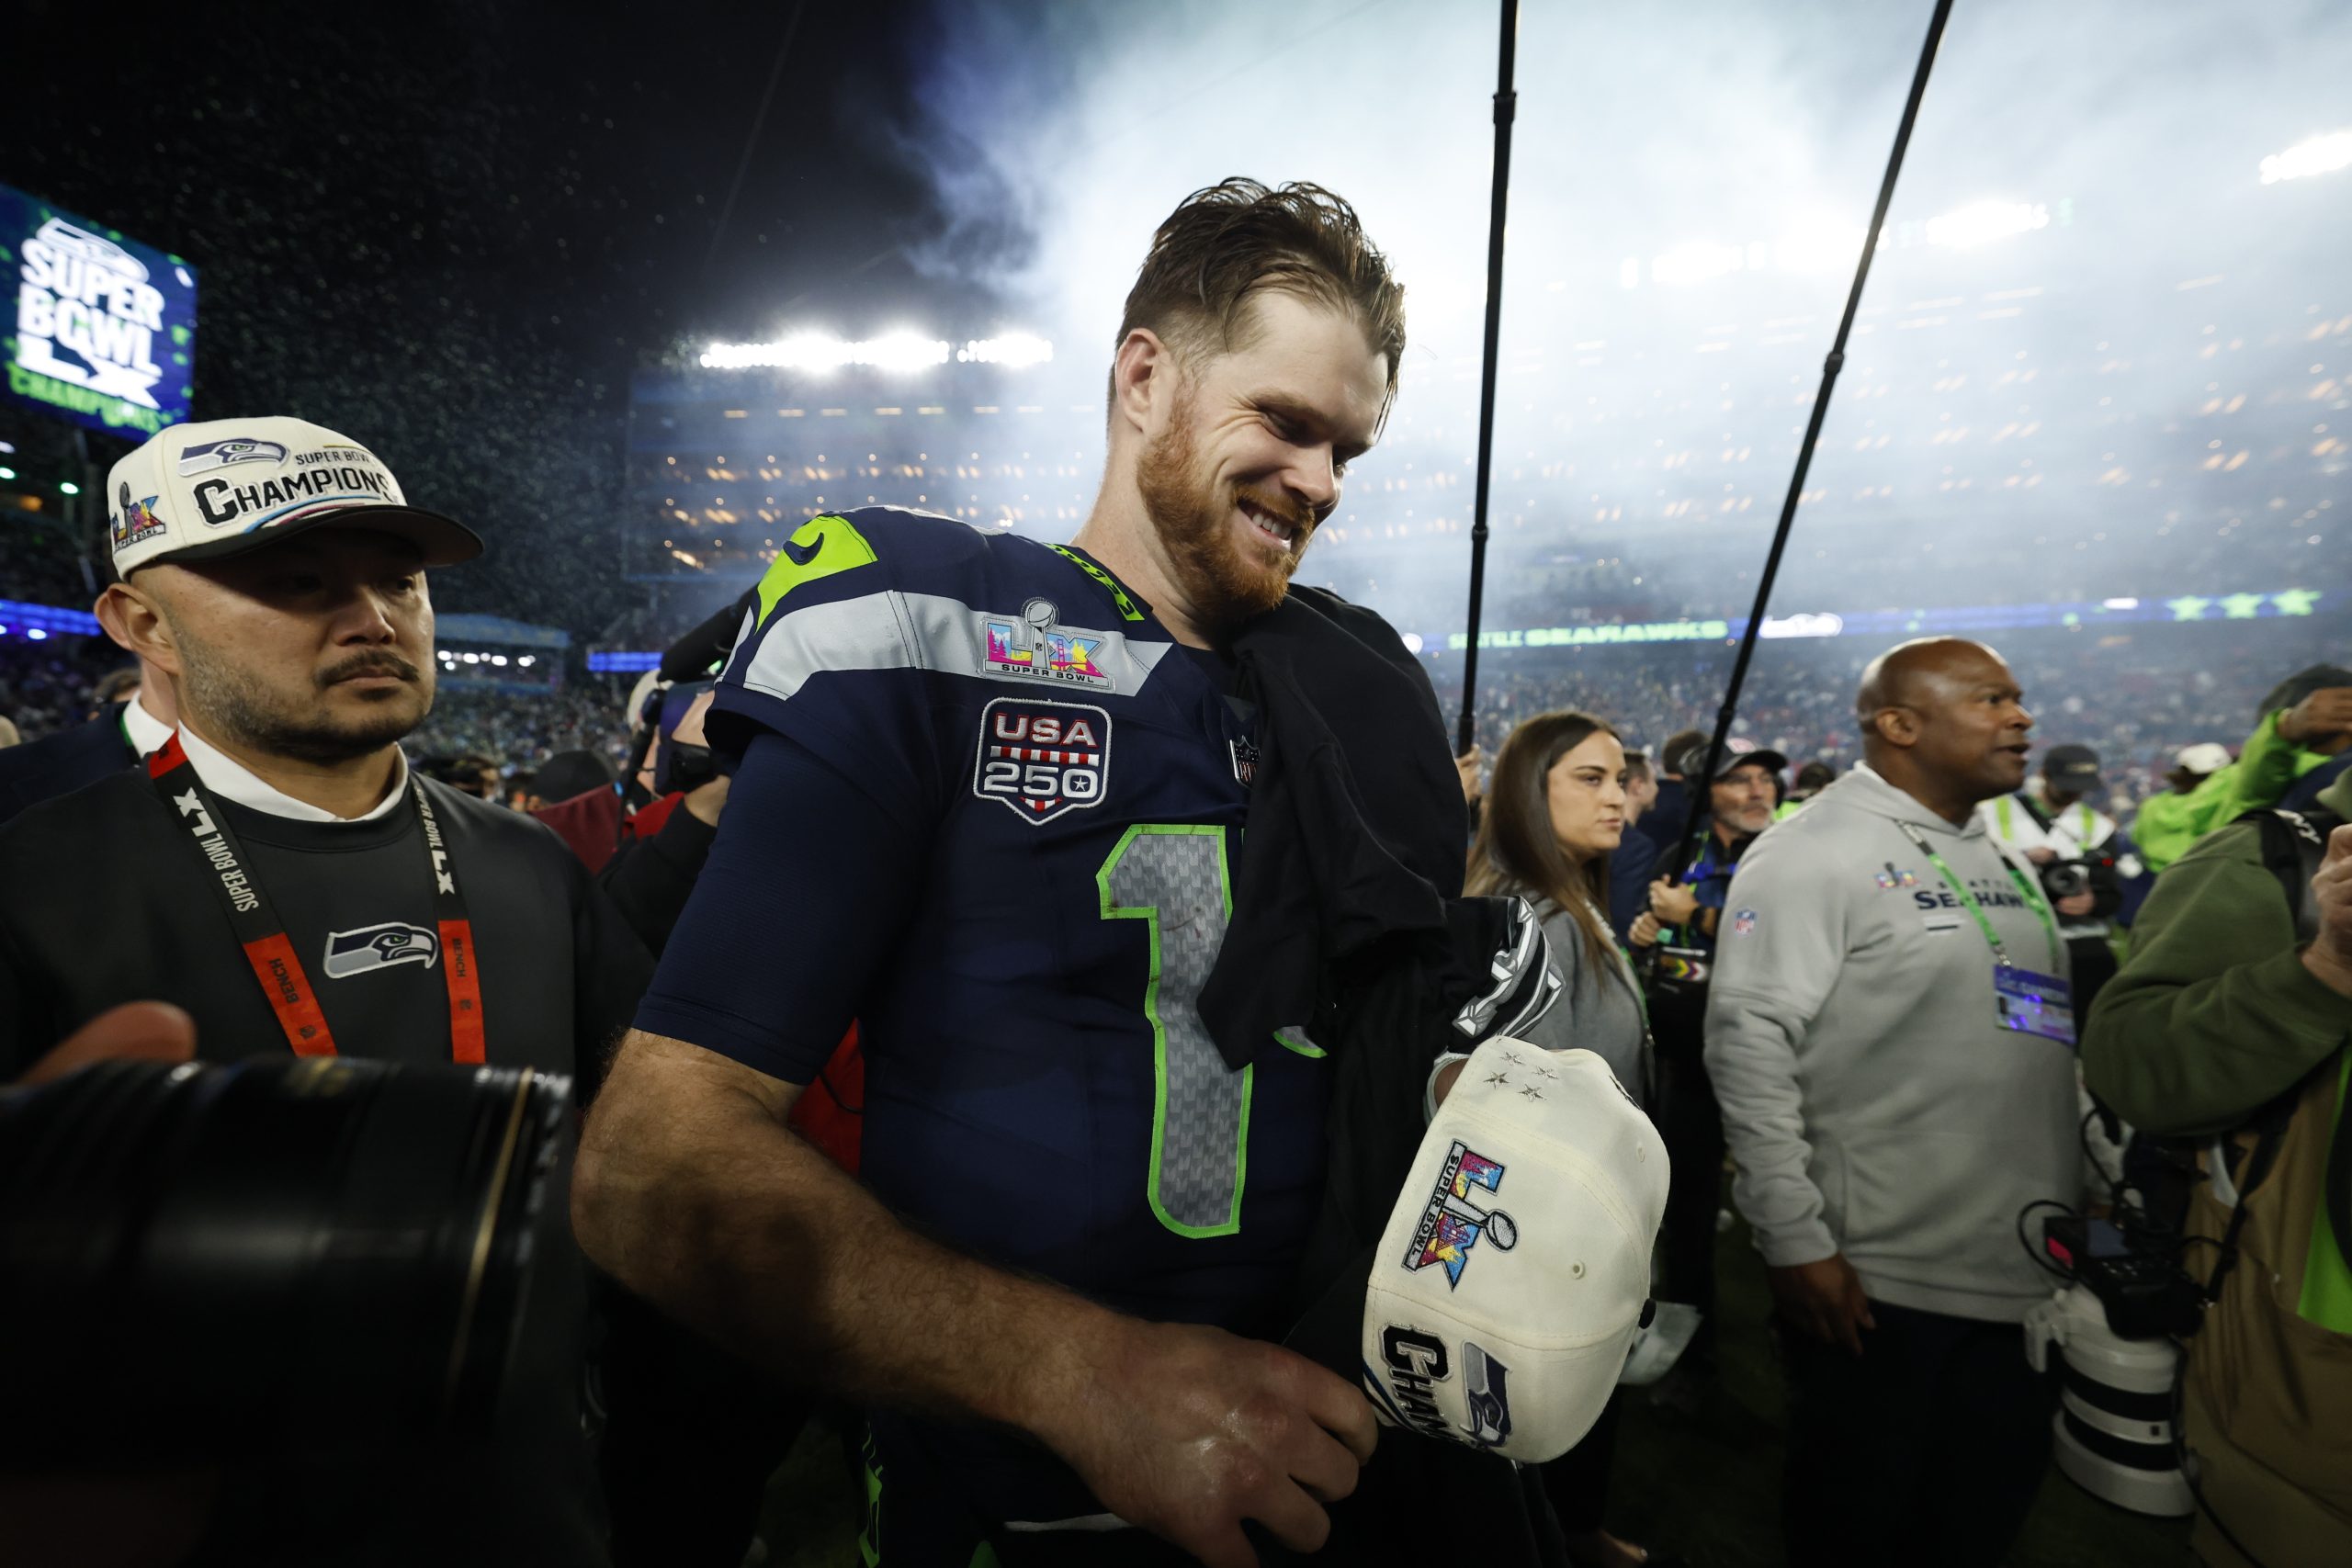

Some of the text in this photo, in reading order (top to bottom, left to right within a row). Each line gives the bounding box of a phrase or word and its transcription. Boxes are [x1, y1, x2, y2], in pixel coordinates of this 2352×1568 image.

[21, 238, 165, 332] SUPER
[17, 281, 163, 378] BOWL
[295, 451, 369, 465] SUPER BOW
[193, 467, 391, 525] CHAMPIONS
[988, 622, 1104, 678] LX
[1001, 663, 1094, 683] SUPER BOWL
[995, 713, 1099, 748] USA
[983, 761, 1099, 799] 250
[173, 786, 259, 912] SUPER BOWL LX
[424, 818, 443, 848] BOWL
[431, 851, 455, 895] LX
[453, 938, 467, 977] BENCH
[268, 958, 300, 1003] BENCH
[1096, 824, 1328, 1239] 1
[1412, 1154, 1459, 1256] SUPER BOWL
